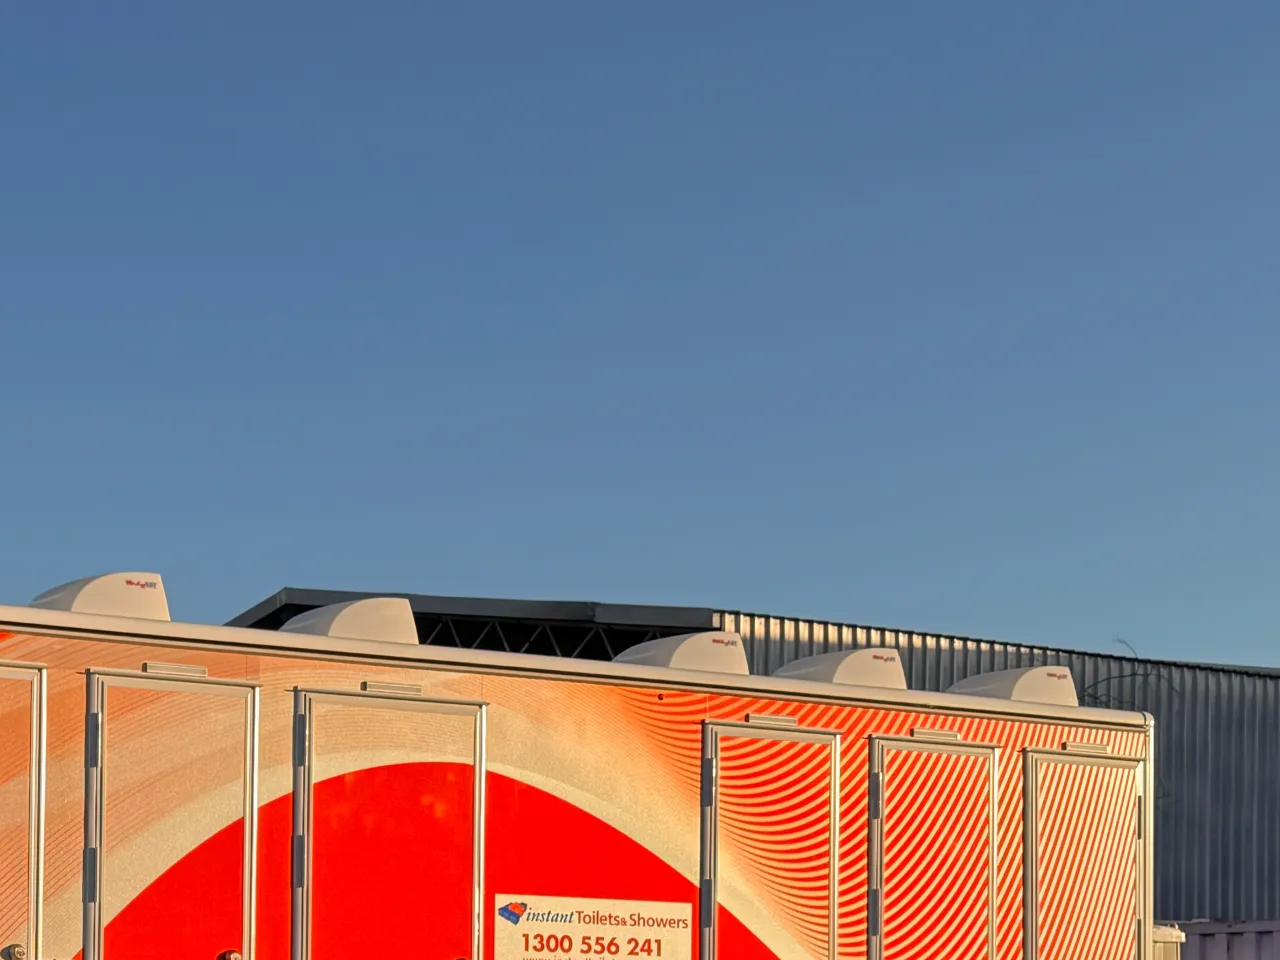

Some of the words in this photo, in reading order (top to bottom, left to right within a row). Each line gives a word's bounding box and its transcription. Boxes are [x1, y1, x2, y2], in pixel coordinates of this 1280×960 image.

[526, 908, 575, 924] instant
[522, 933, 573, 953] 1300
[580, 935, 620, 956] 556
[626, 937, 662, 957] 241
